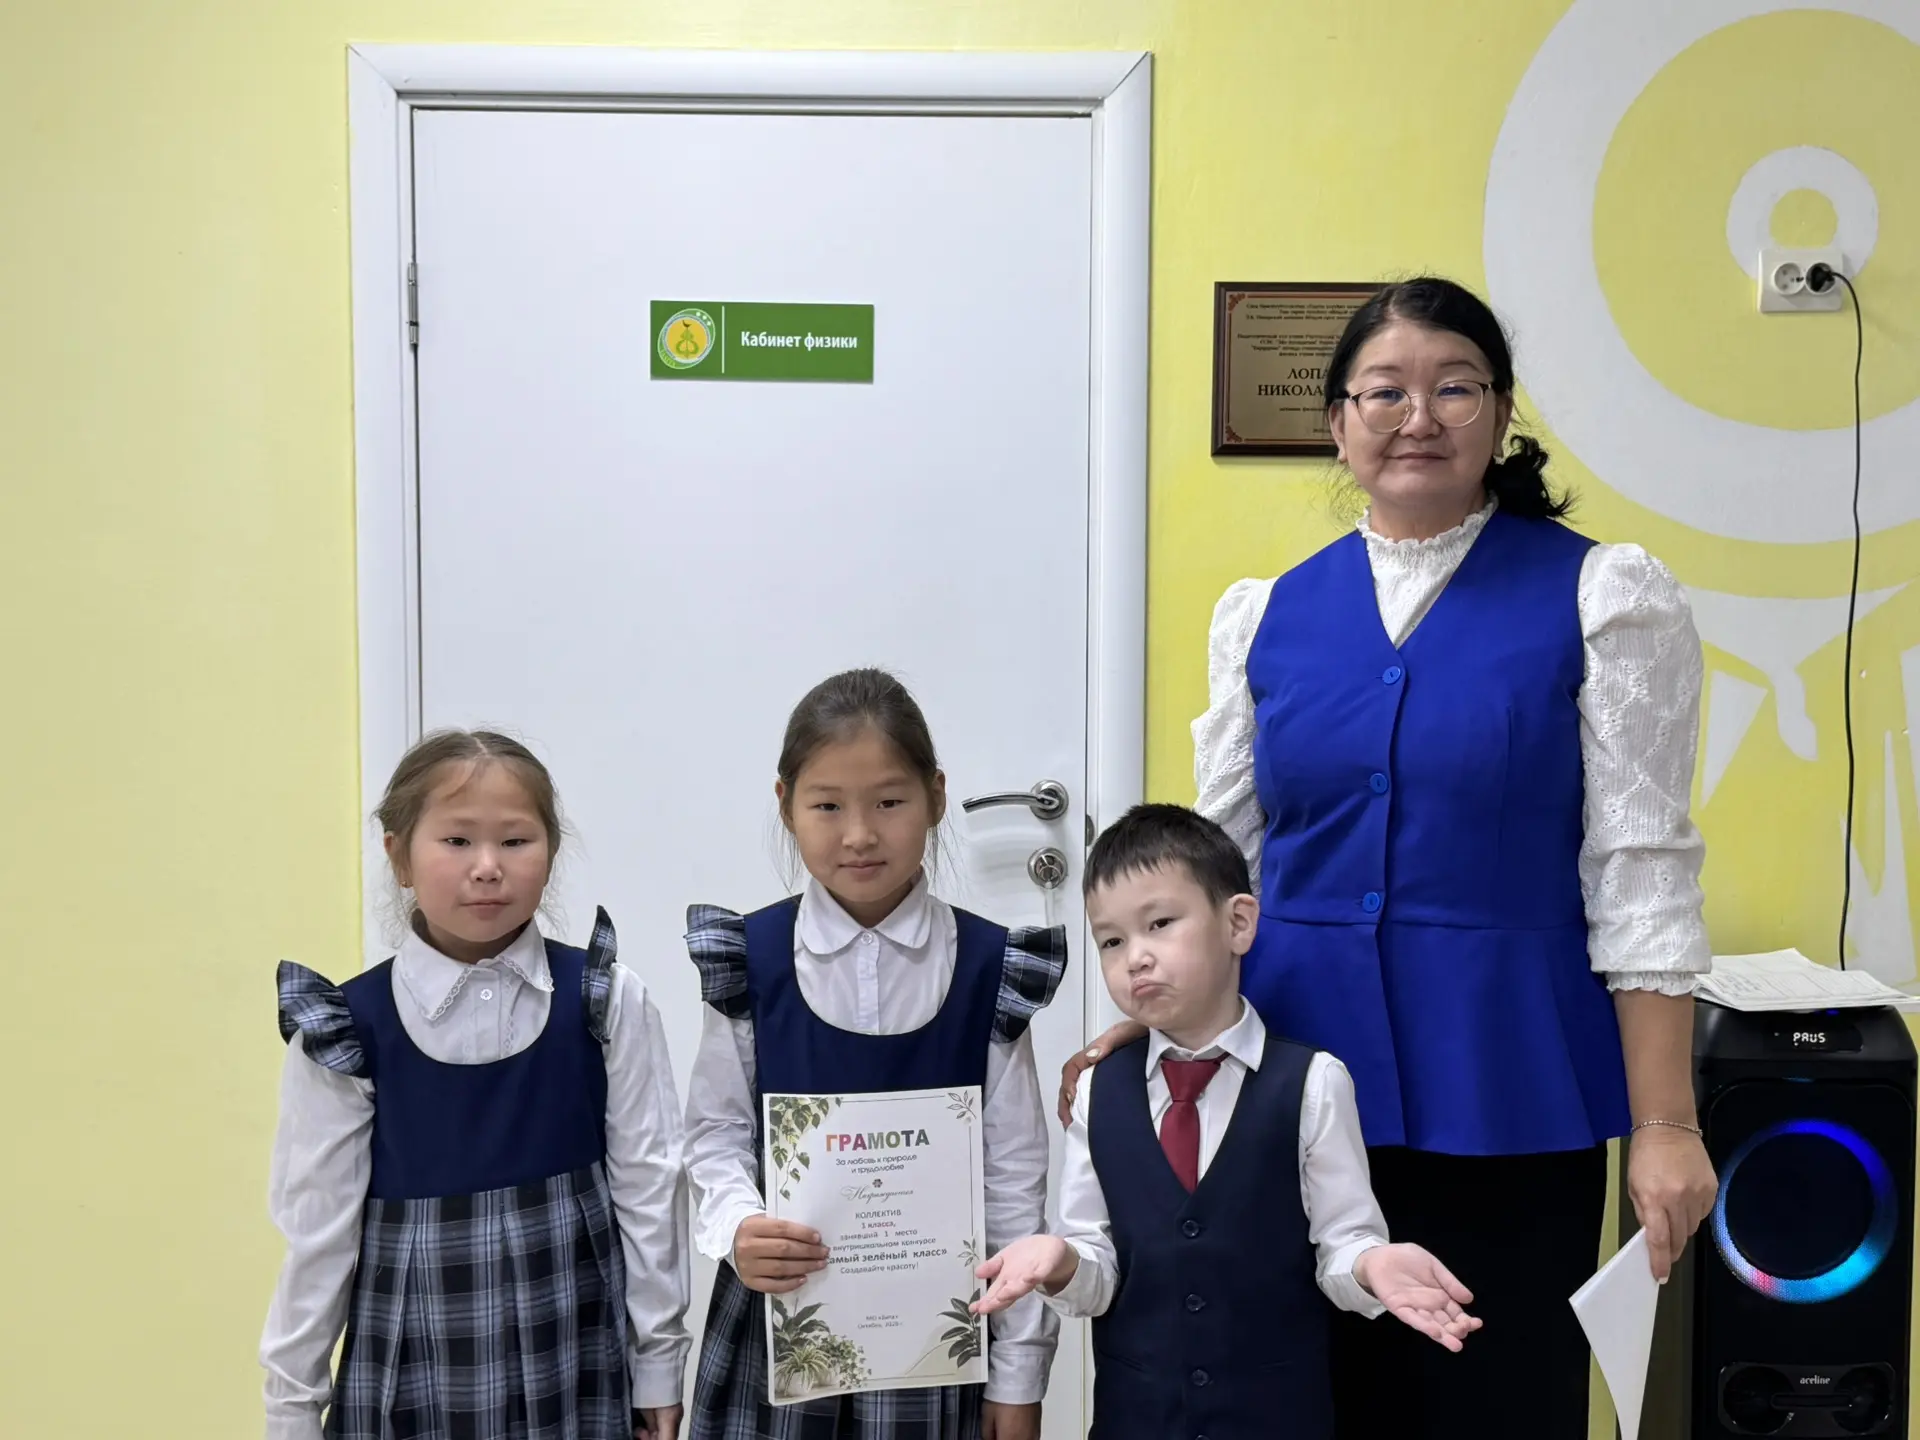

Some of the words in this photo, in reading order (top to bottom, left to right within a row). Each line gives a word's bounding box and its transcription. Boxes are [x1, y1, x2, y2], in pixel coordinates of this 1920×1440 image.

[741, 331, 802, 348] Кабинет
[804, 332, 858, 352] физики
[1257, 384, 1325, 396] НИКОЛА
[825, 1129, 930, 1152] ГРАМОТА
[836, 1158, 846, 1166] За
[847, 1156, 876, 1165] любовь
[882, 1154, 918, 1164] природе
[858, 1163, 904, 1174] трудолюбие
[855, 1209, 902, 1220] КОЛЛЕКТИВ
[901, 1238, 936, 1247] конкурсе
[862, 1250, 907, 1262] зелёный
[913, 1248, 947, 1258] класс»
[1800, 1374, 1830, 1384] aceline
